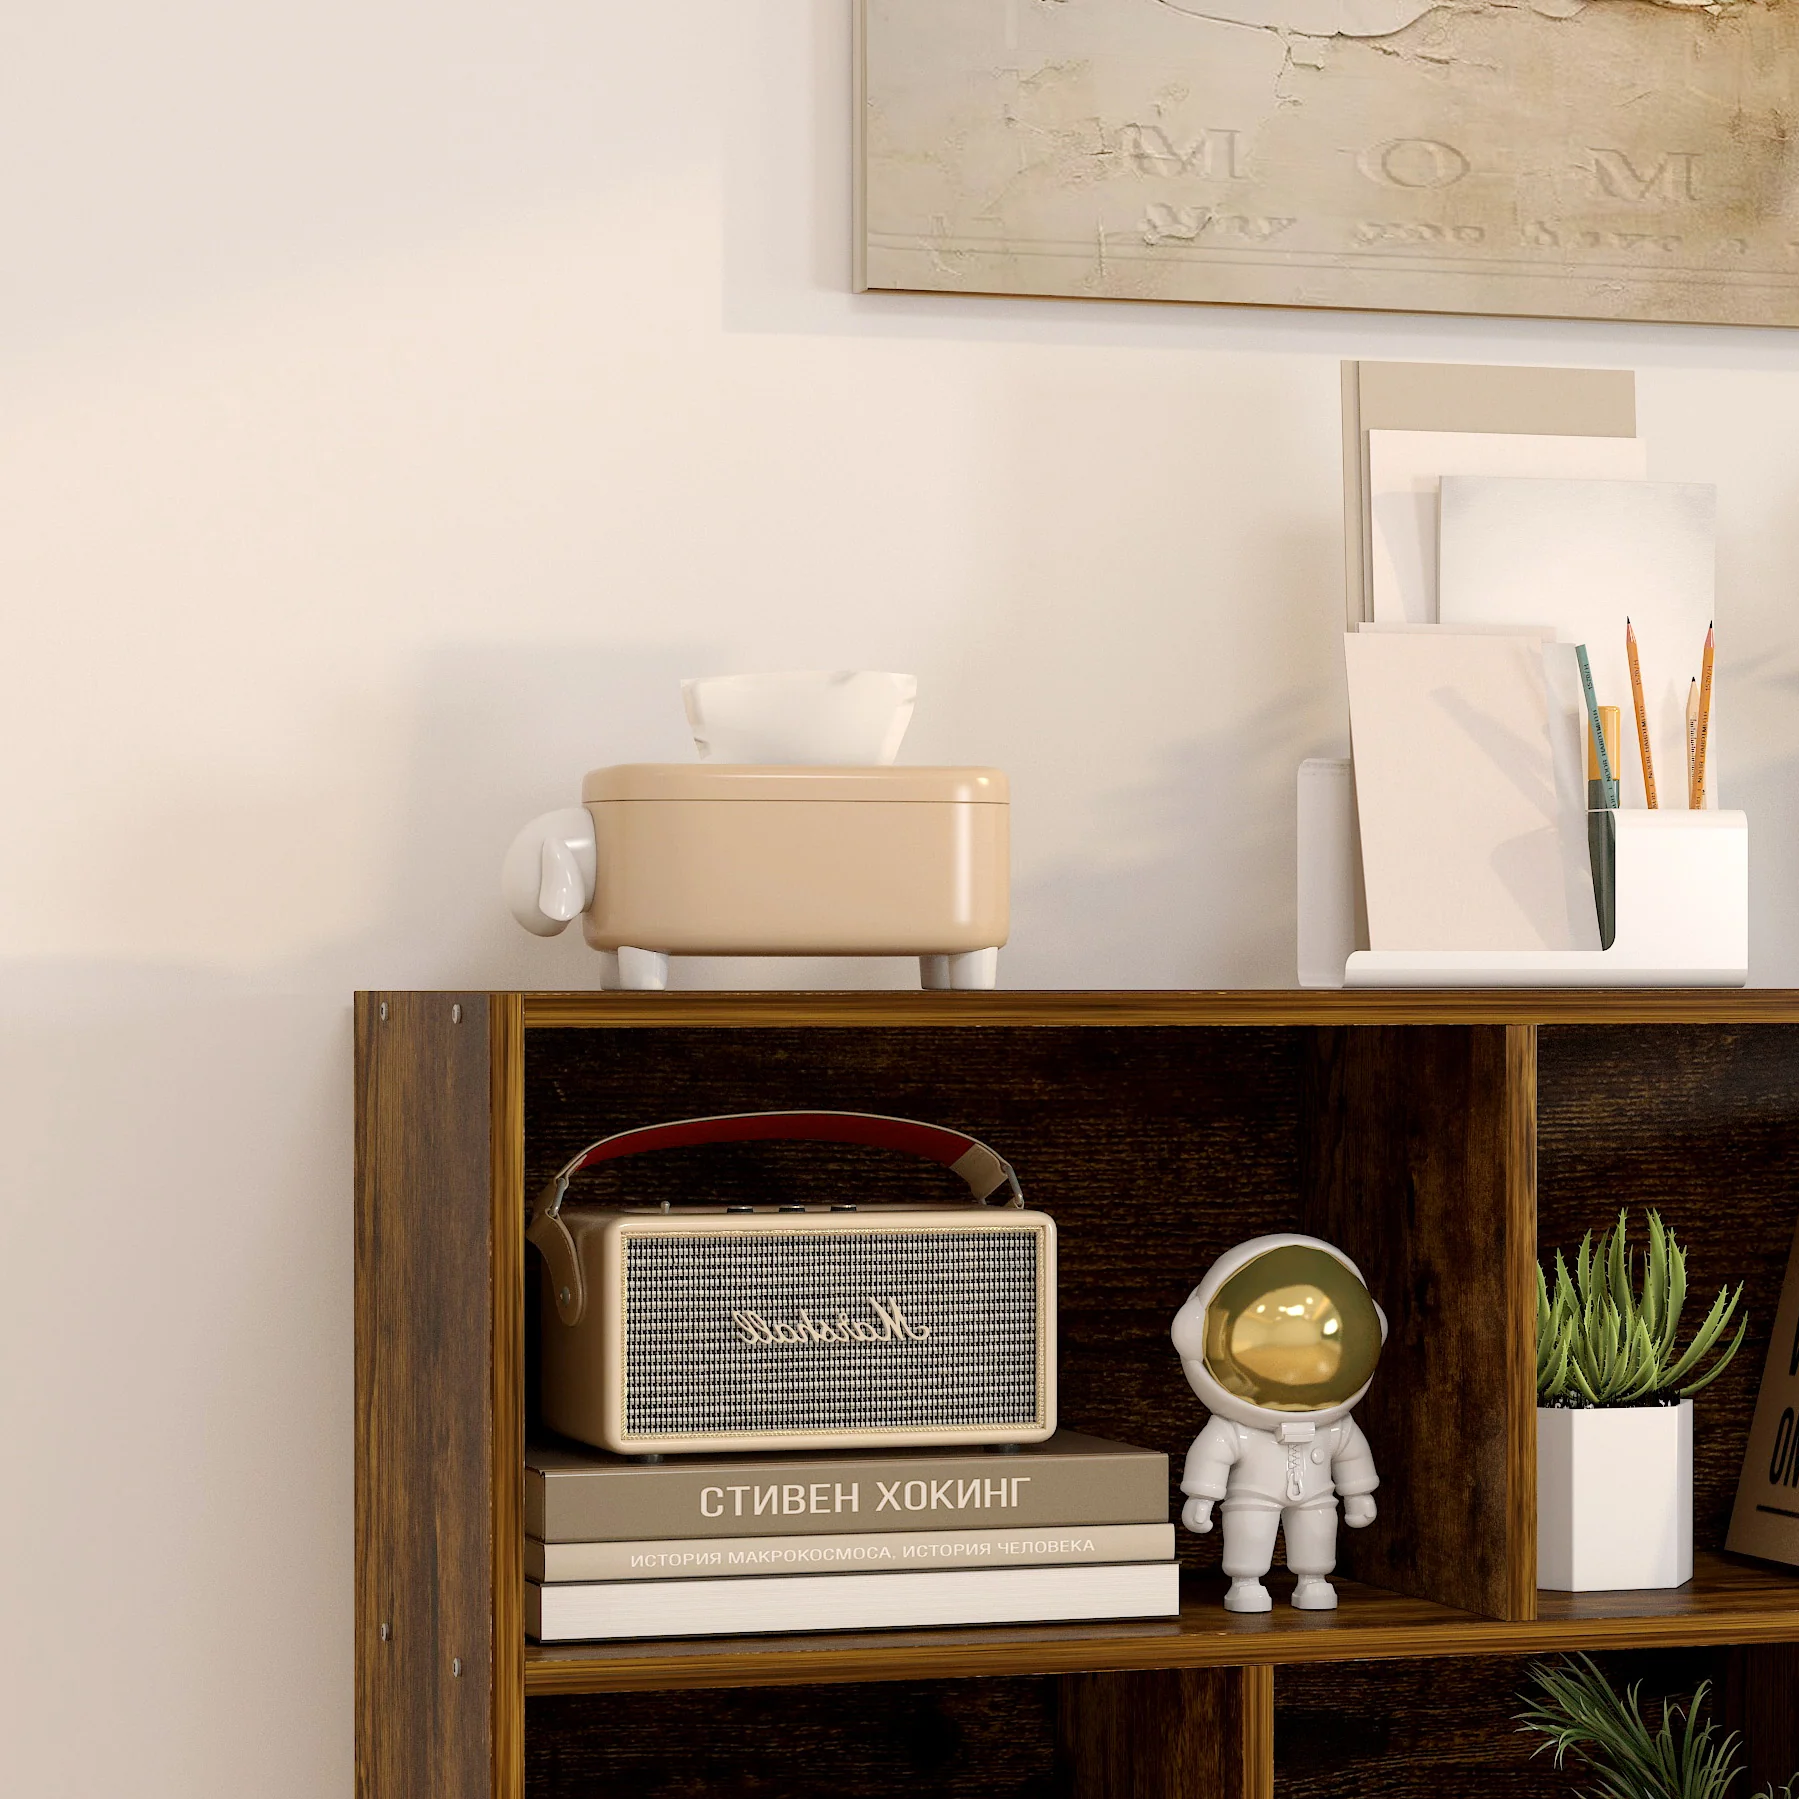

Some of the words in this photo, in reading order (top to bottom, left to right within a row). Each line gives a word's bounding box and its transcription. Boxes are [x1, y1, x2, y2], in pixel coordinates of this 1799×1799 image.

[699, 1482, 860, 1518] СТИВЕН
[875, 1476, 1031, 1513] ХОКИНГ
[630, 1550, 721, 1568] ИСТОРИЯ
[902, 1542, 991, 1559] ИСТОРИЯ
[997, 1537, 1095, 1556] ЧЕЛОВЕКА
